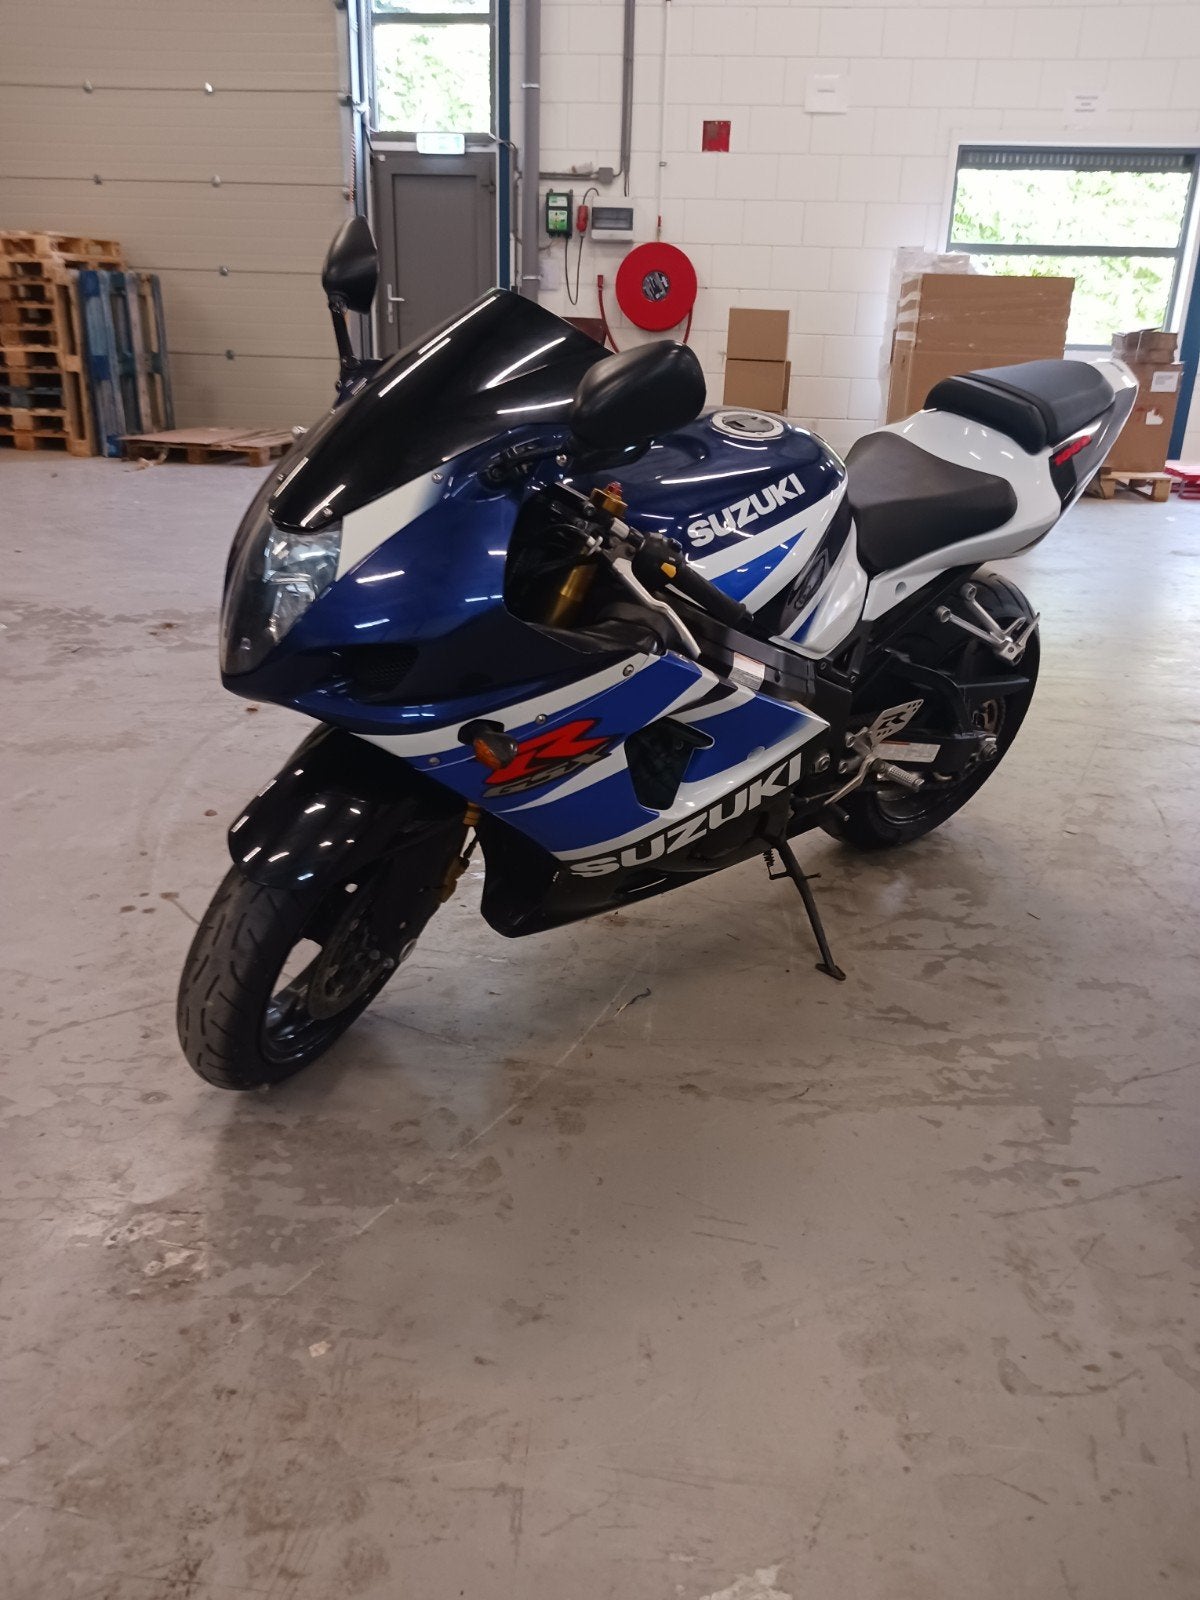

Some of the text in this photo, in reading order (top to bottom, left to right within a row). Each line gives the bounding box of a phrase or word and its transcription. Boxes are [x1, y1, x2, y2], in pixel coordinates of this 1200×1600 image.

[687, 473, 806, 547] SUZUKI
[485, 720, 610, 784] R
[569, 753, 801, 878] SUZUKI
